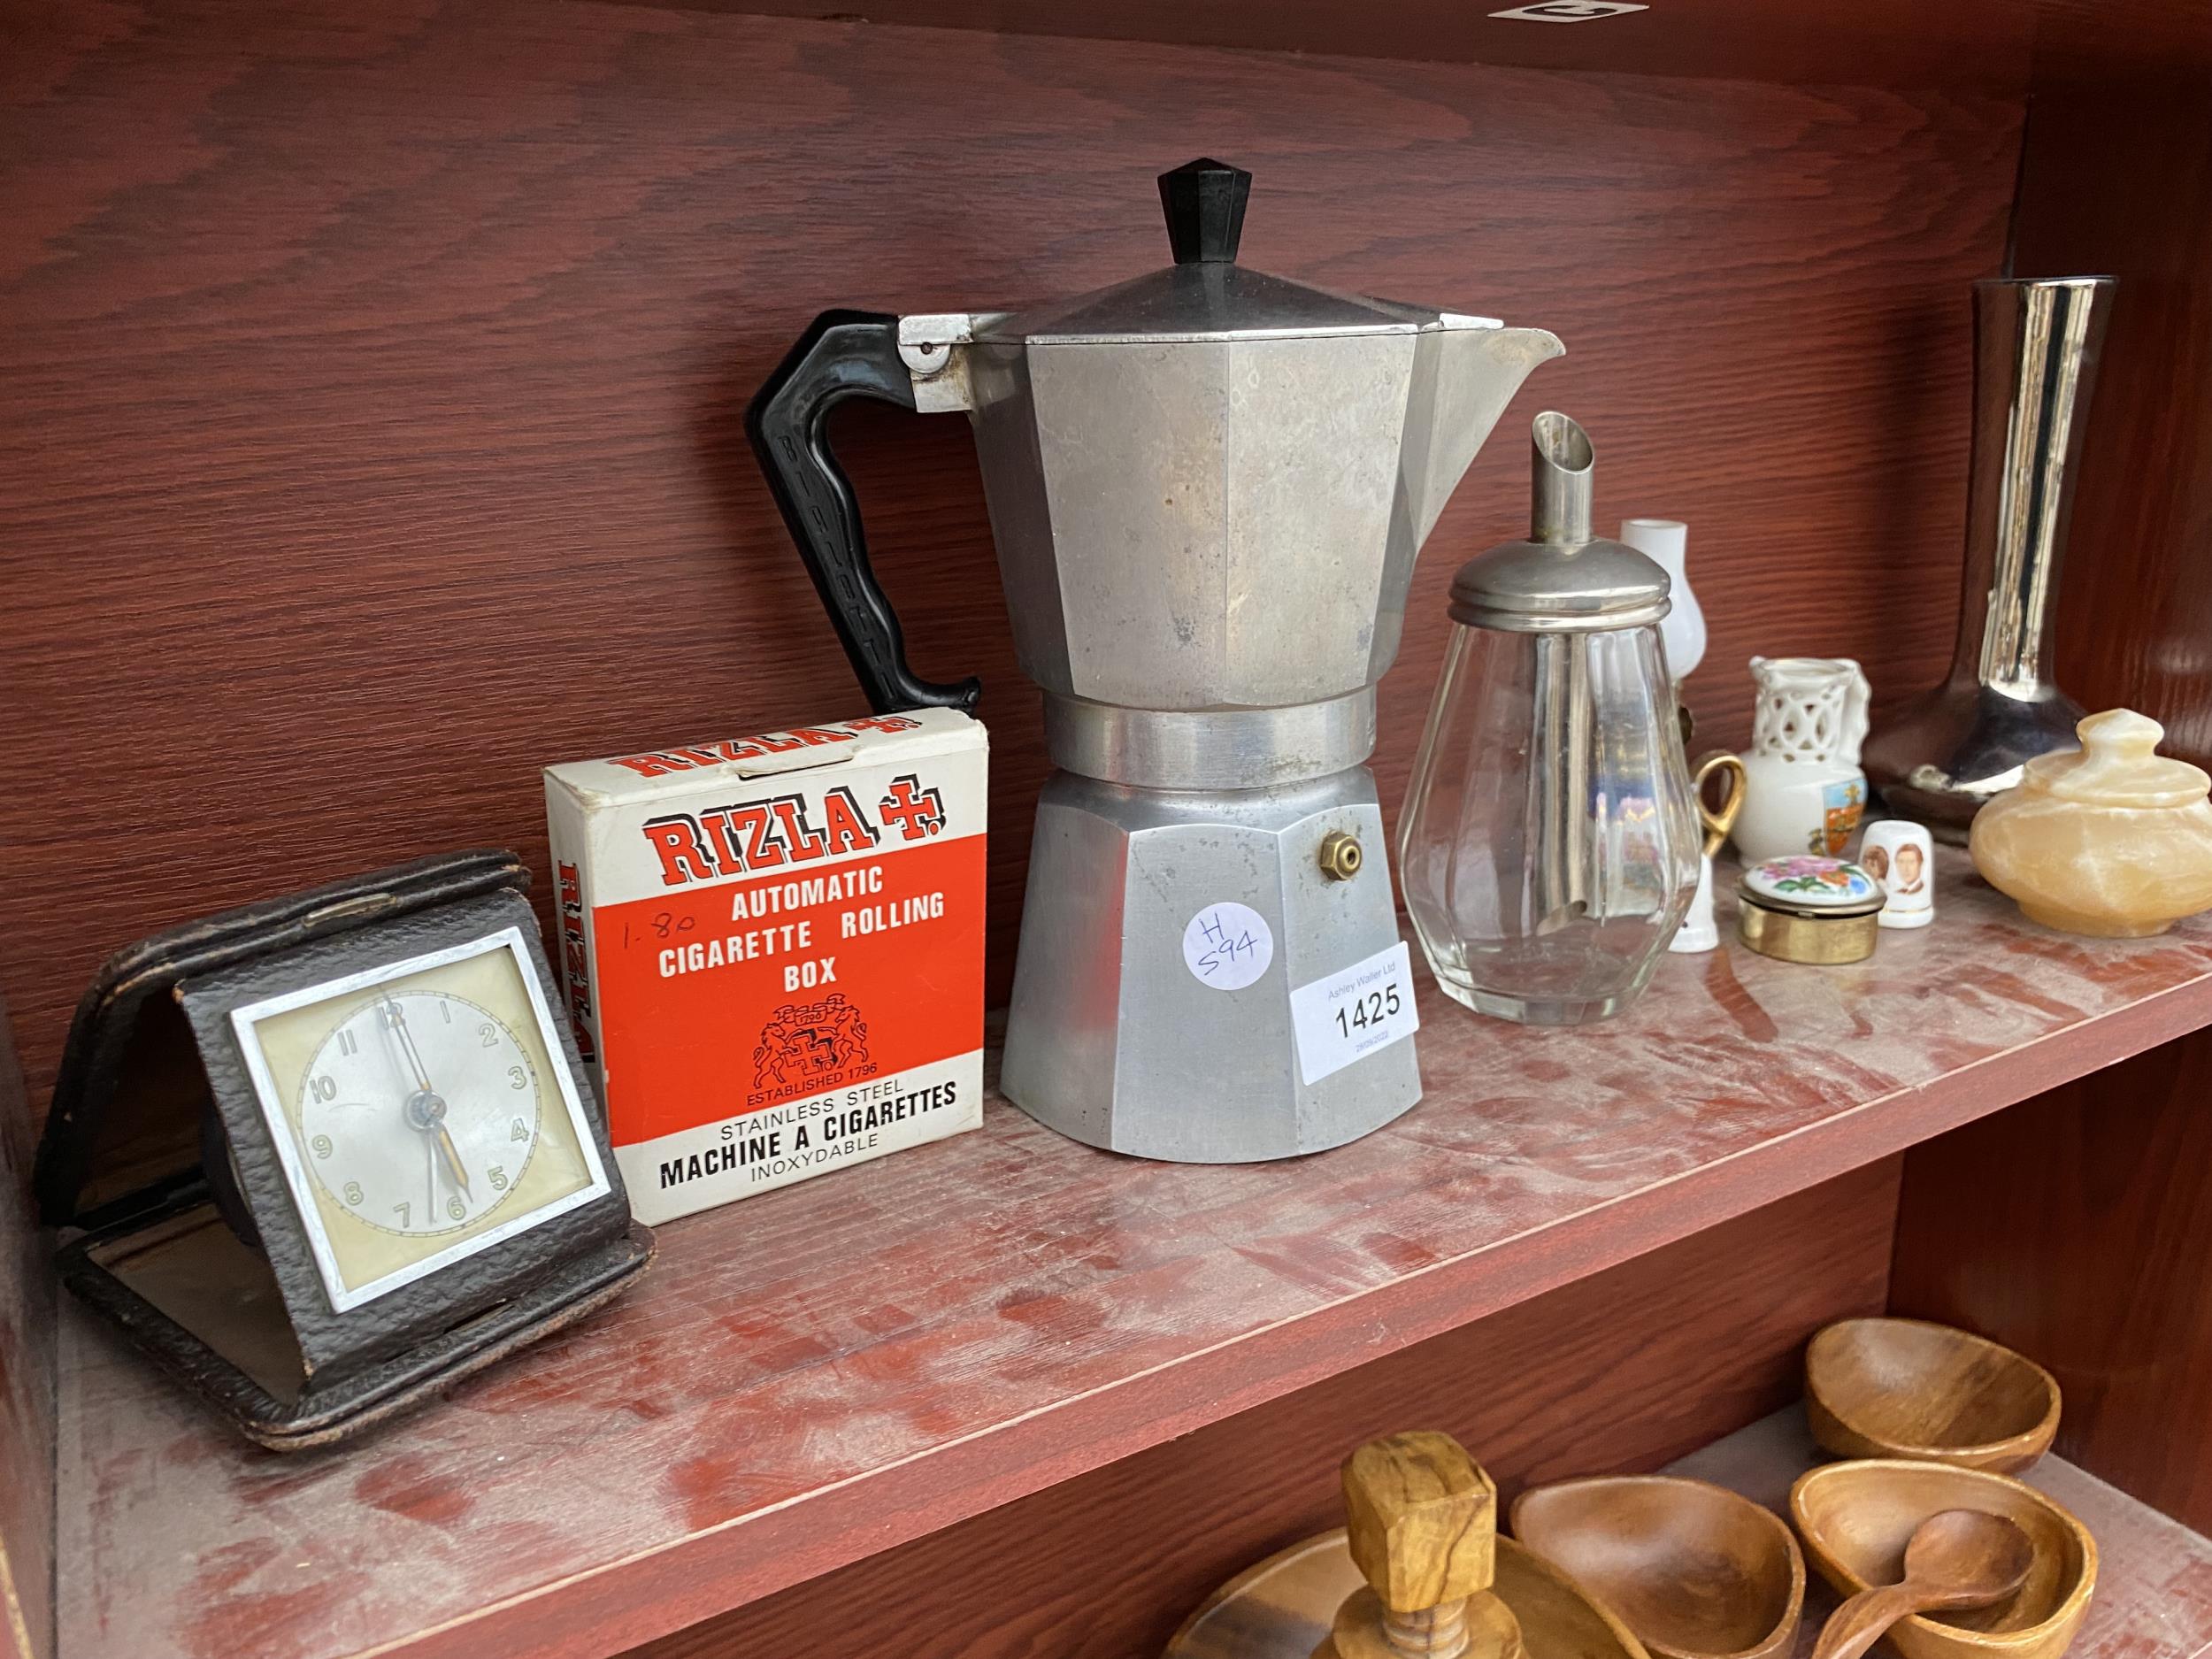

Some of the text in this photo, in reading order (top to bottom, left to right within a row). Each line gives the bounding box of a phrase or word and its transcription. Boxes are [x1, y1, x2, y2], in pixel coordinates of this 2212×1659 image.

[778, 434, 896, 701] BIALETTI
[607, 727, 856, 778] RIZLA
[641, 785, 882, 887] RIZLA
[732, 866, 883, 921] AUTOMATIC
[658, 891, 944, 979] CIGARETTE ROLLING
[1198, 912, 1225, 944] H
[784, 956, 837, 993] BOX
[1328, 982, 1356, 1001] Ashley
[1383, 961, 1396, 975] Ltd
[1335, 982, 1401, 1039] 1425
[337, 1030, 358, 1056] 11
[478, 1023, 500, 1048] 2
[310, 1075, 337, 1104] 10
[508, 1066, 527, 1090] 3
[747, 1062, 878, 1107] ESTABLISHED 1796
[720, 1079, 904, 1141] STAINLESS STEEL
[311, 1134, 333, 1159] 9
[510, 1118, 530, 1143] 4
[660, 1080, 957, 1189] MACHINE A CIGARETTES
[750, 1133, 879, 1183] INOXYDABLE
[343, 1181, 365, 1206] 8
[488, 1166, 509, 1191] 5
[394, 1202, 411, 1229] 7
[446, 1196, 467, 1221] 6
